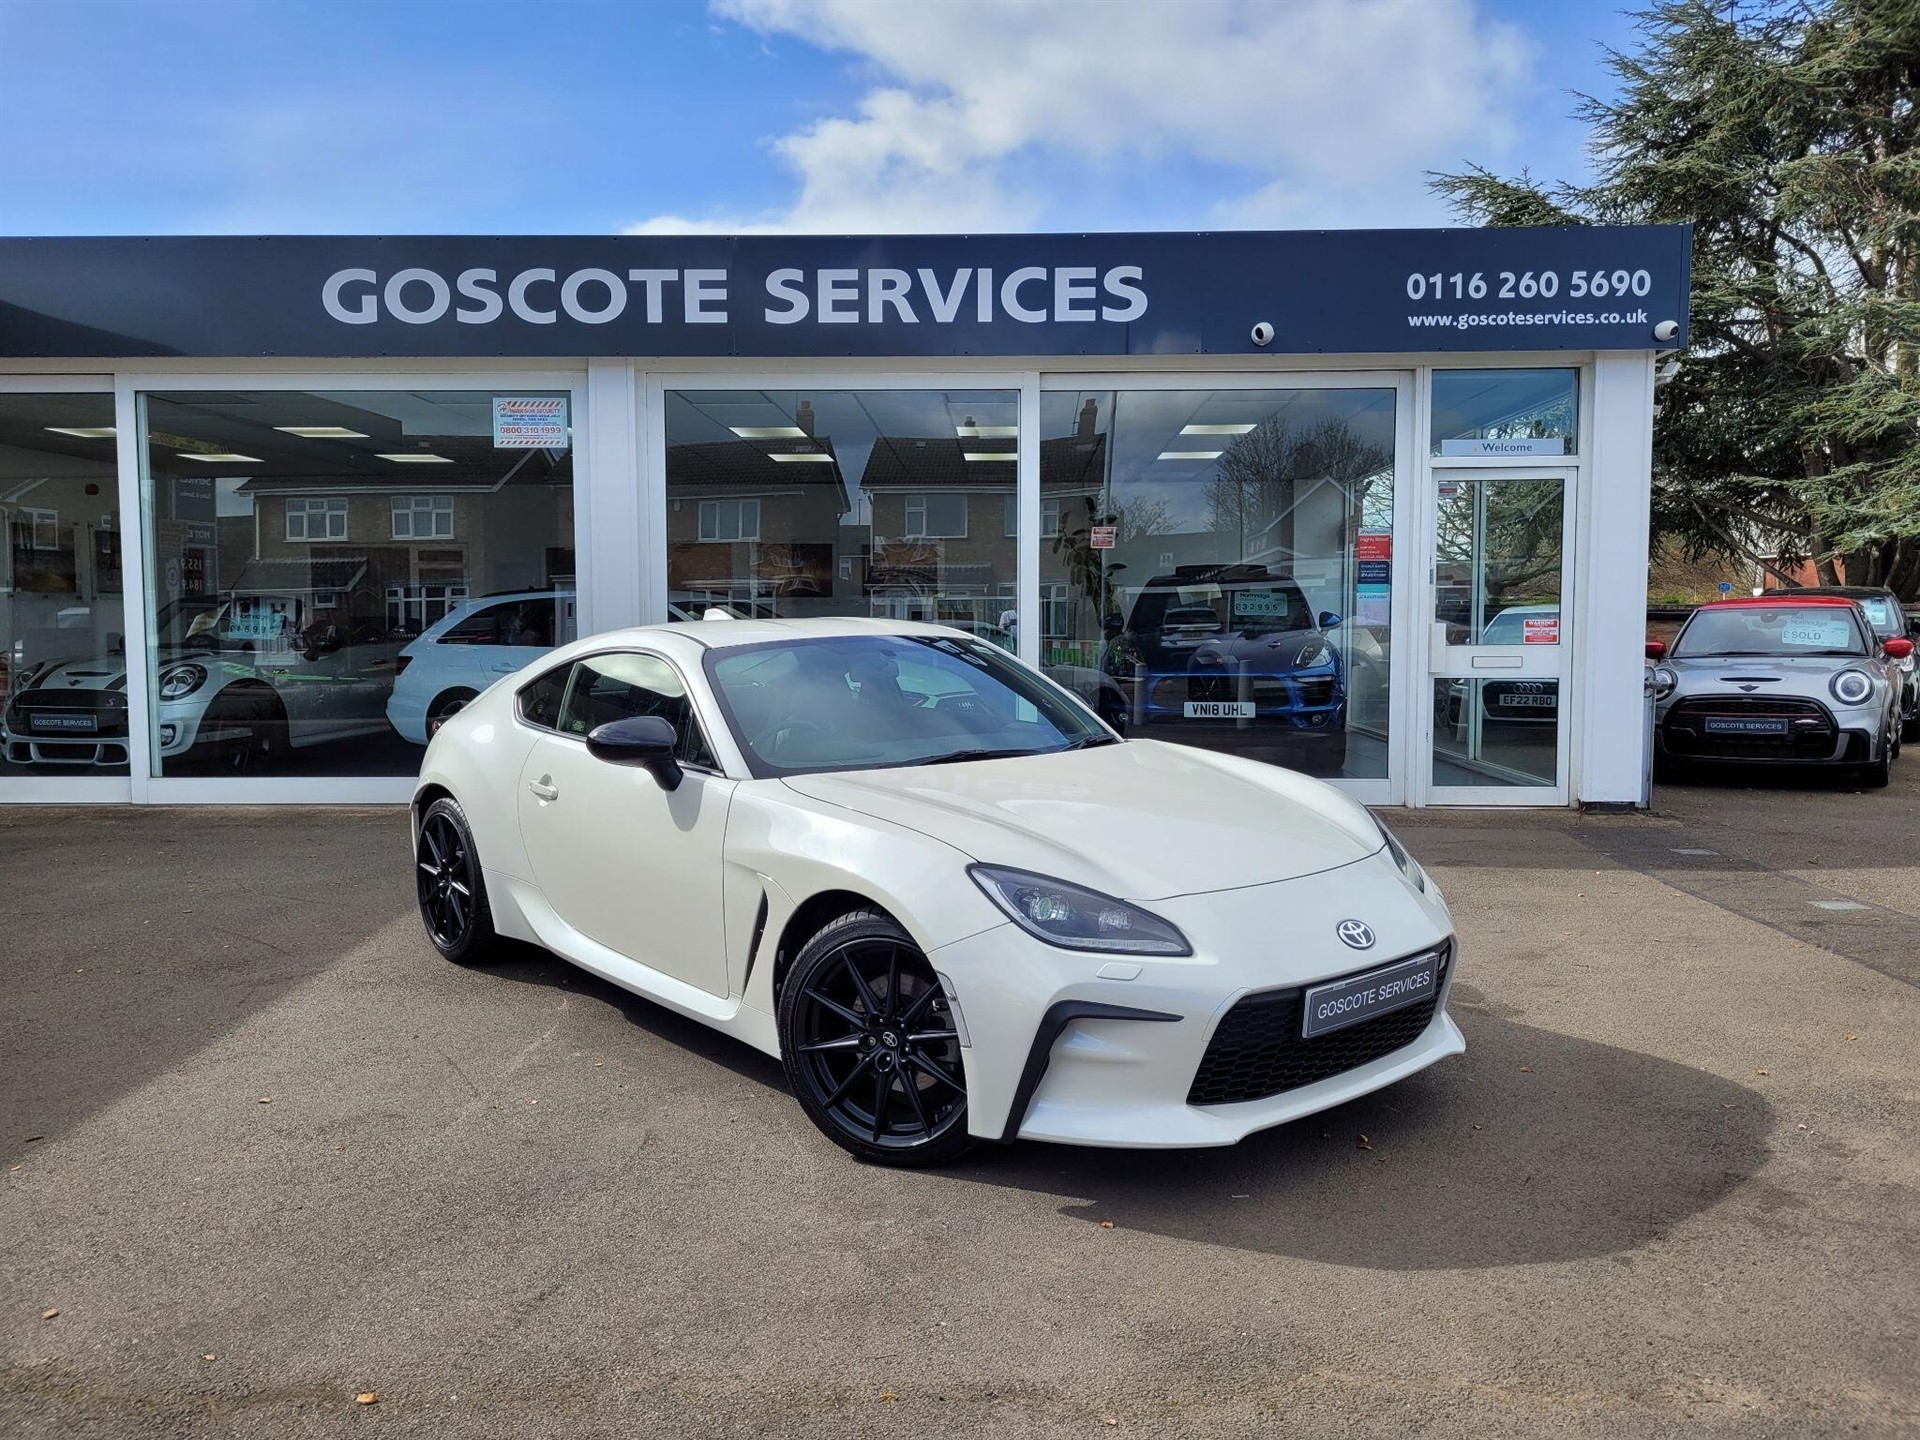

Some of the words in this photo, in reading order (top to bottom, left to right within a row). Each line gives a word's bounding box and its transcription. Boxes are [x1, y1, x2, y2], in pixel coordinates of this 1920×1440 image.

[1406, 273, 1488, 300] 0116
[1498, 271, 1559, 298] 260
[1569, 269, 1651, 298] 5690
[322, 268, 728, 324] GOSCOTE
[764, 266, 1149, 324] SERVICES
[1408, 308, 1648, 330] www.goscoteservices.co.uk
[1482, 442, 1533, 452] Welcome
[1236, 603, 1278, 611] £32995
[1791, 631, 1821, 641] SOLD
[1503, 696, 1530, 705] EF22
[1532, 696, 1552, 706] RBO
[1192, 703, 1220, 716] VN18
[1223, 703, 1247, 716] UHL
[1710, 722, 1745, 730] GOSCOTE
[1745, 723, 1782, 731] SERVICES
[1317, 988, 1377, 1019] GOSCOTE
[1378, 970, 1431, 1001] SERVICES
